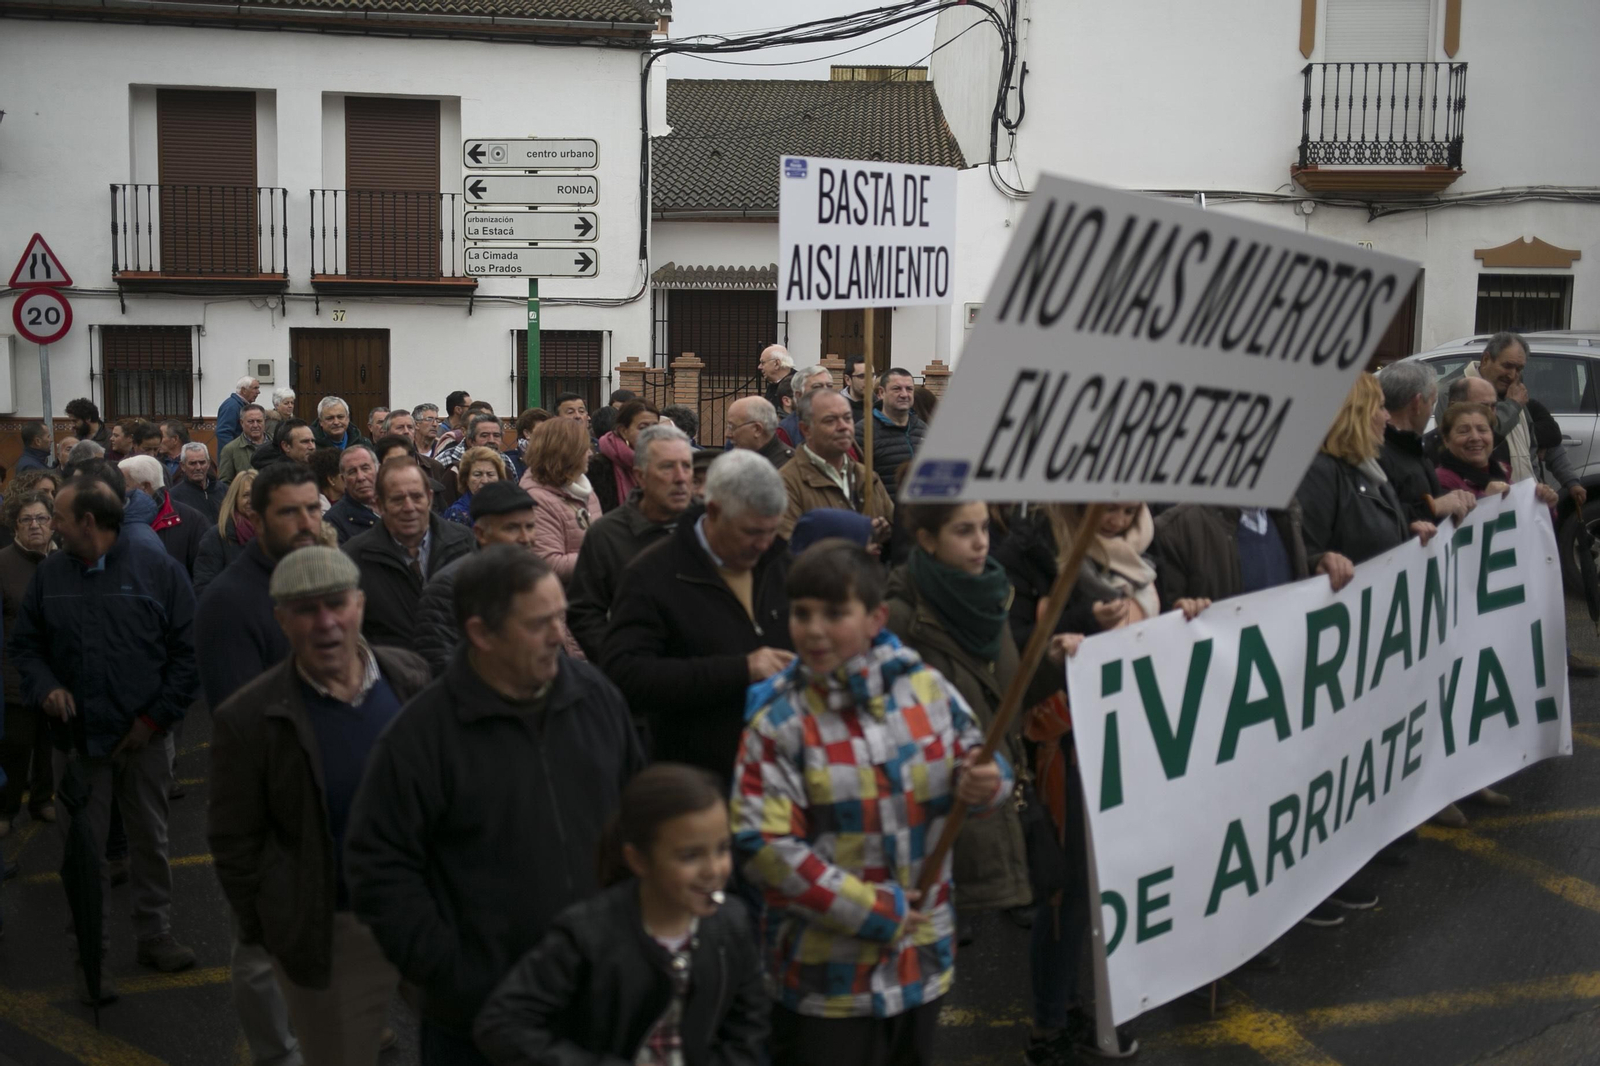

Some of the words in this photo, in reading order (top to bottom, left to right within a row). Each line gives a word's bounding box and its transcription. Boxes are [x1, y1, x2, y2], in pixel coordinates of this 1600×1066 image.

[526, 150, 558, 158] centro
[560, 150, 595, 158] urbano
[557, 185, 594, 195] RONDA
[818, 167, 896, 227] BASTA
[902, 173, 931, 228] DE
[467, 216, 514, 224] urbanización
[467, 226, 479, 236] La
[482, 226, 514, 236] Estacá
[468, 251, 480, 260] La
[482, 251, 519, 260] Cimada
[468, 264, 486, 273] Los
[488, 264, 522, 273] Prados
[786, 243, 949, 301] AISLAMIENTO
[997, 196, 1105, 329] NO
[1074, 214, 1211, 341] MAS
[1178, 231, 1397, 372] MUERTOS
[27, 306, 60, 326] 20
[332, 309, 346, 322] 37
[974, 368, 1070, 481] EN
[1044, 372, 1294, 490] CARRETERA
[1099, 509, 1526, 813] ¡VARIANTE
[1099, 865, 1174, 959] DE
[1203, 700, 1428, 919] ARRIATE
[1438, 618, 1559, 758] YA!
